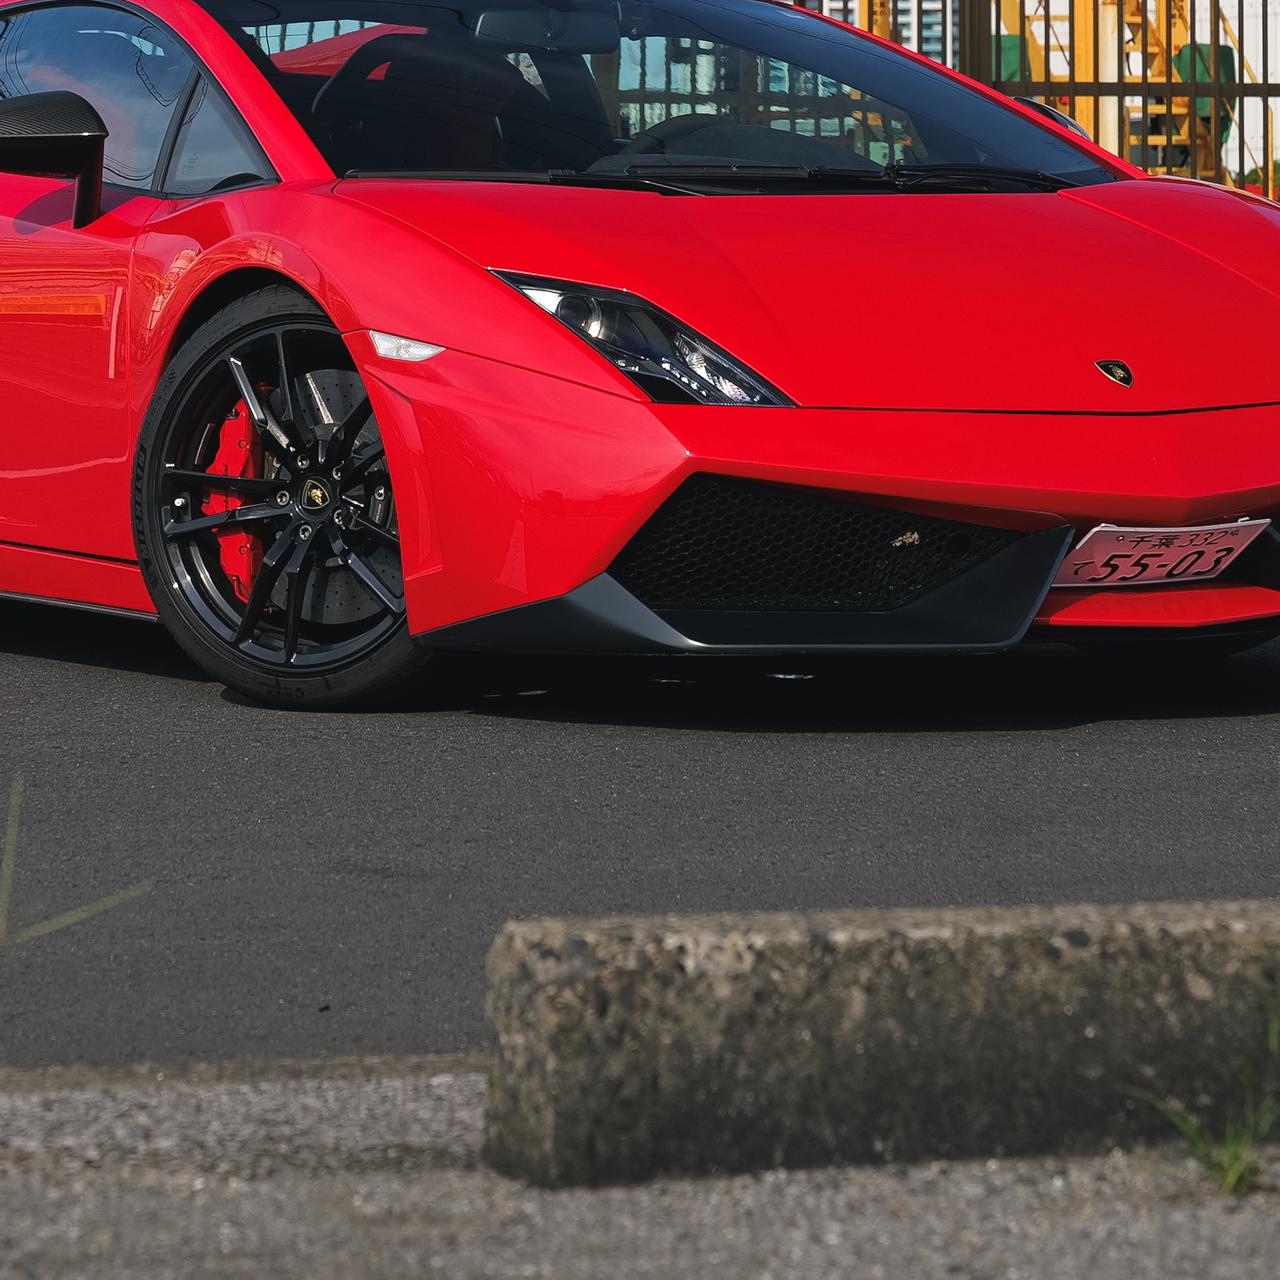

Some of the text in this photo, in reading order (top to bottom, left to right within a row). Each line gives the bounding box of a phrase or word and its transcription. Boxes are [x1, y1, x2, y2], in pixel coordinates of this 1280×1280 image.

[1129, 530, 1229, 550] 千葉 332
[1087, 546, 1235, 583] 55-03
